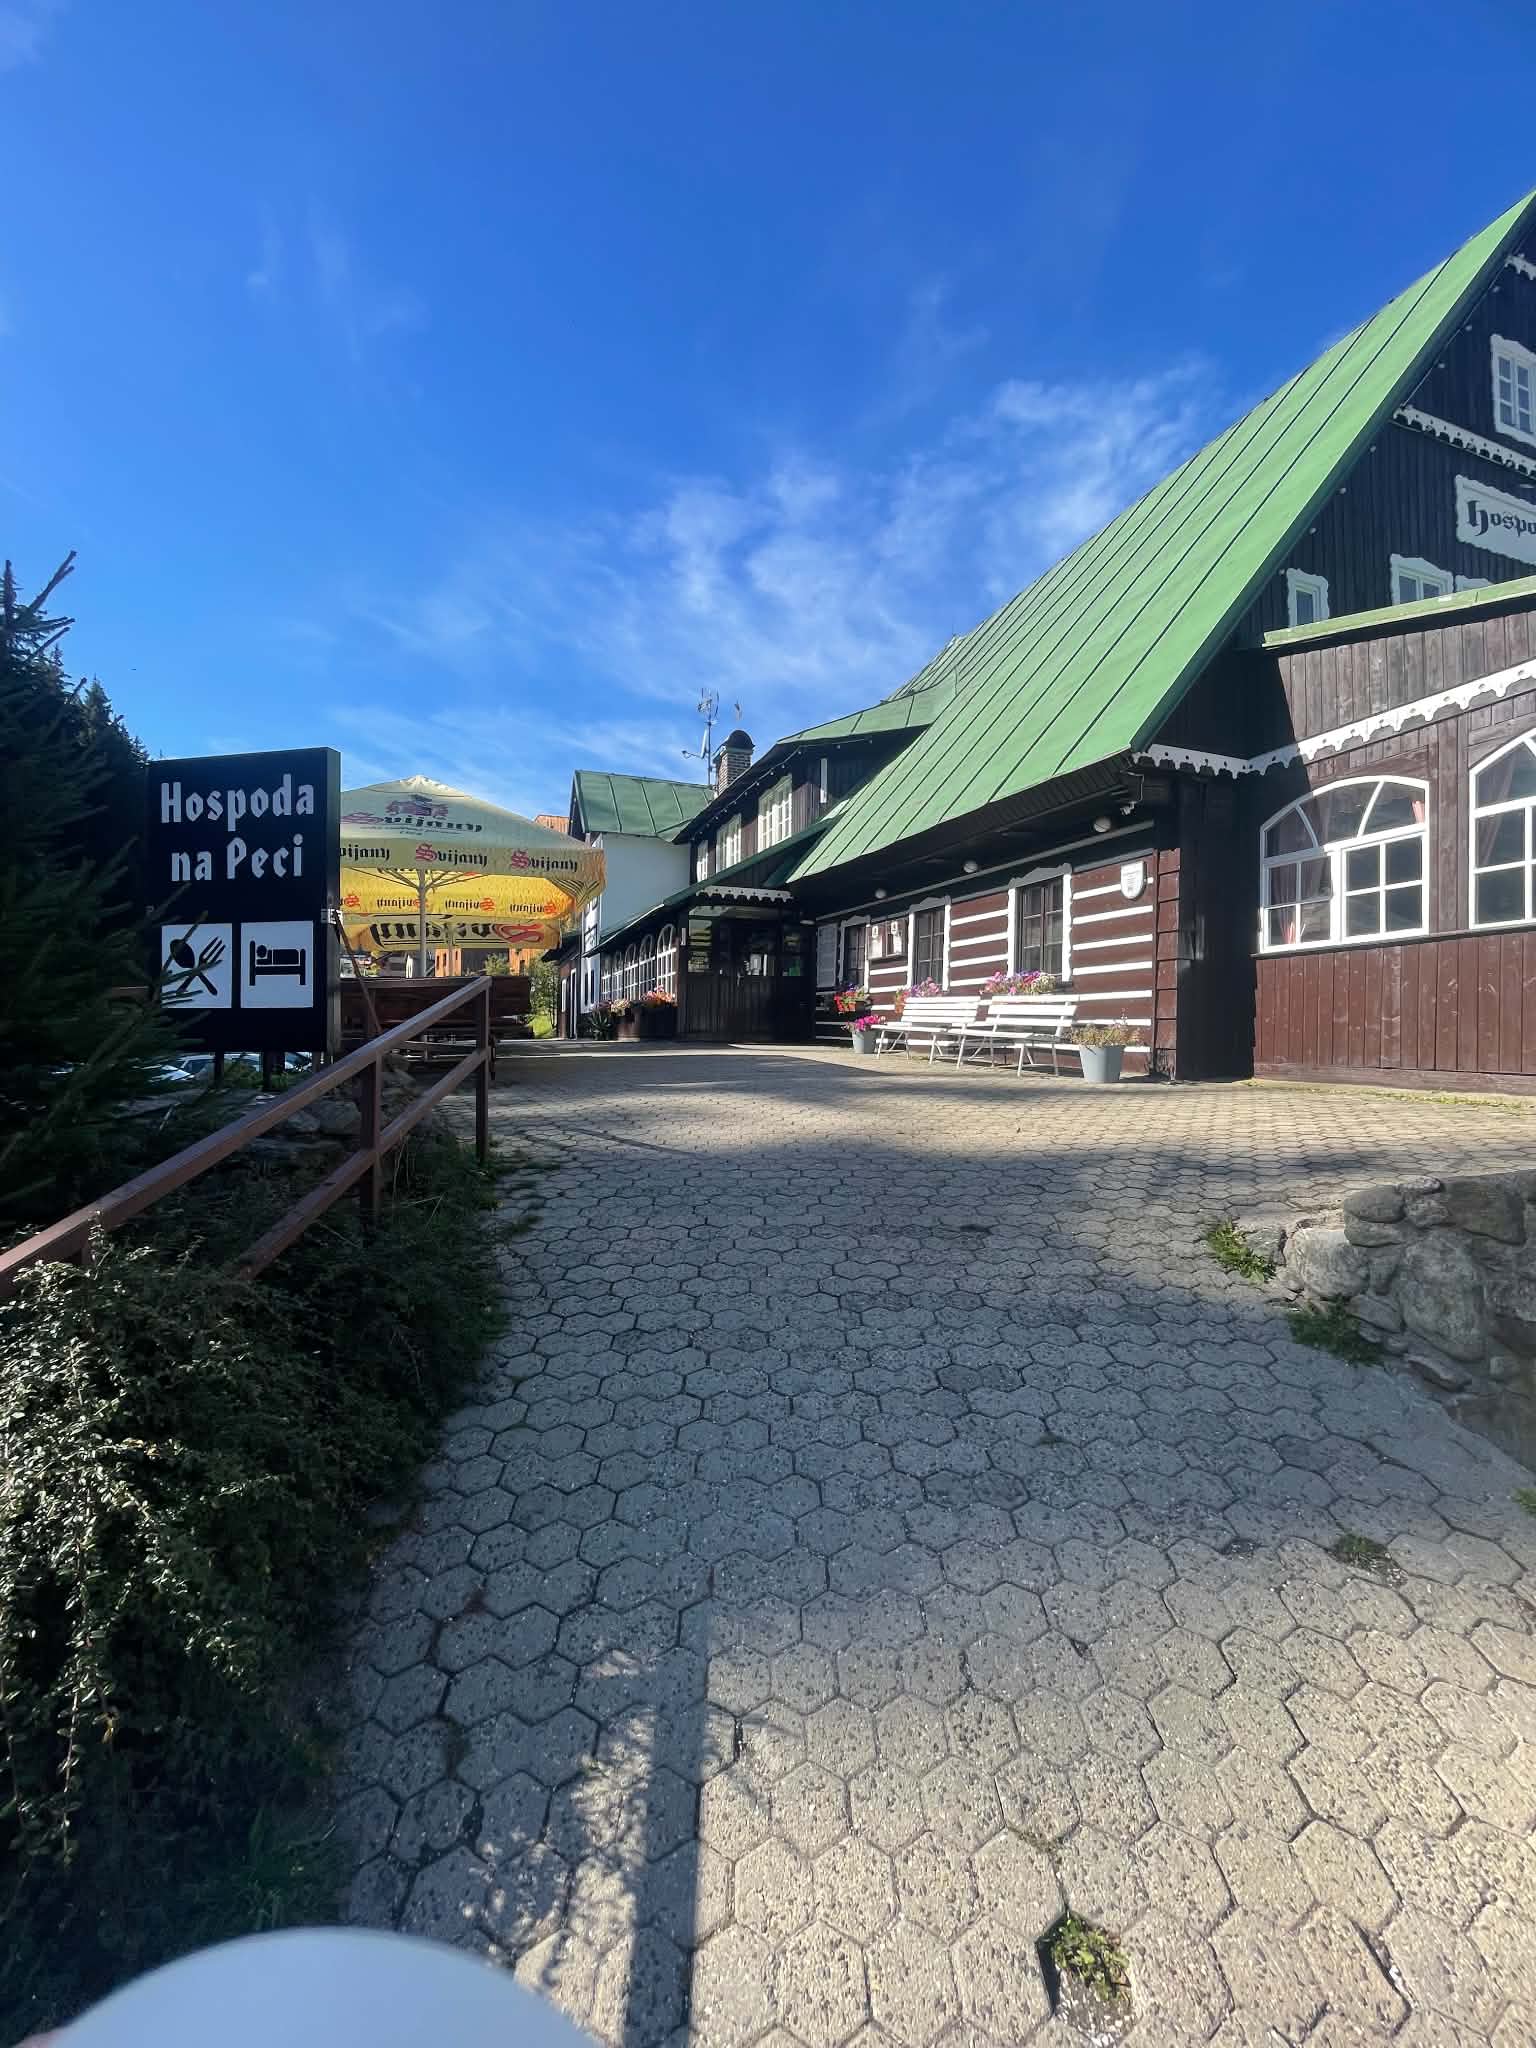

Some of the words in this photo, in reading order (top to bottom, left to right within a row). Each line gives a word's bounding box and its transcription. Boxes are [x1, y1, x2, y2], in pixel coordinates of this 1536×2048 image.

[161, 774, 314, 832] Hospoda
[340, 811, 482, 832] Svijany
[171, 850, 212, 882] na
[226, 833, 304, 880] Peci
[340, 844, 391, 861] vijany
[416, 843, 488, 867] Svijany
[511, 848, 578, 872] Svijany
